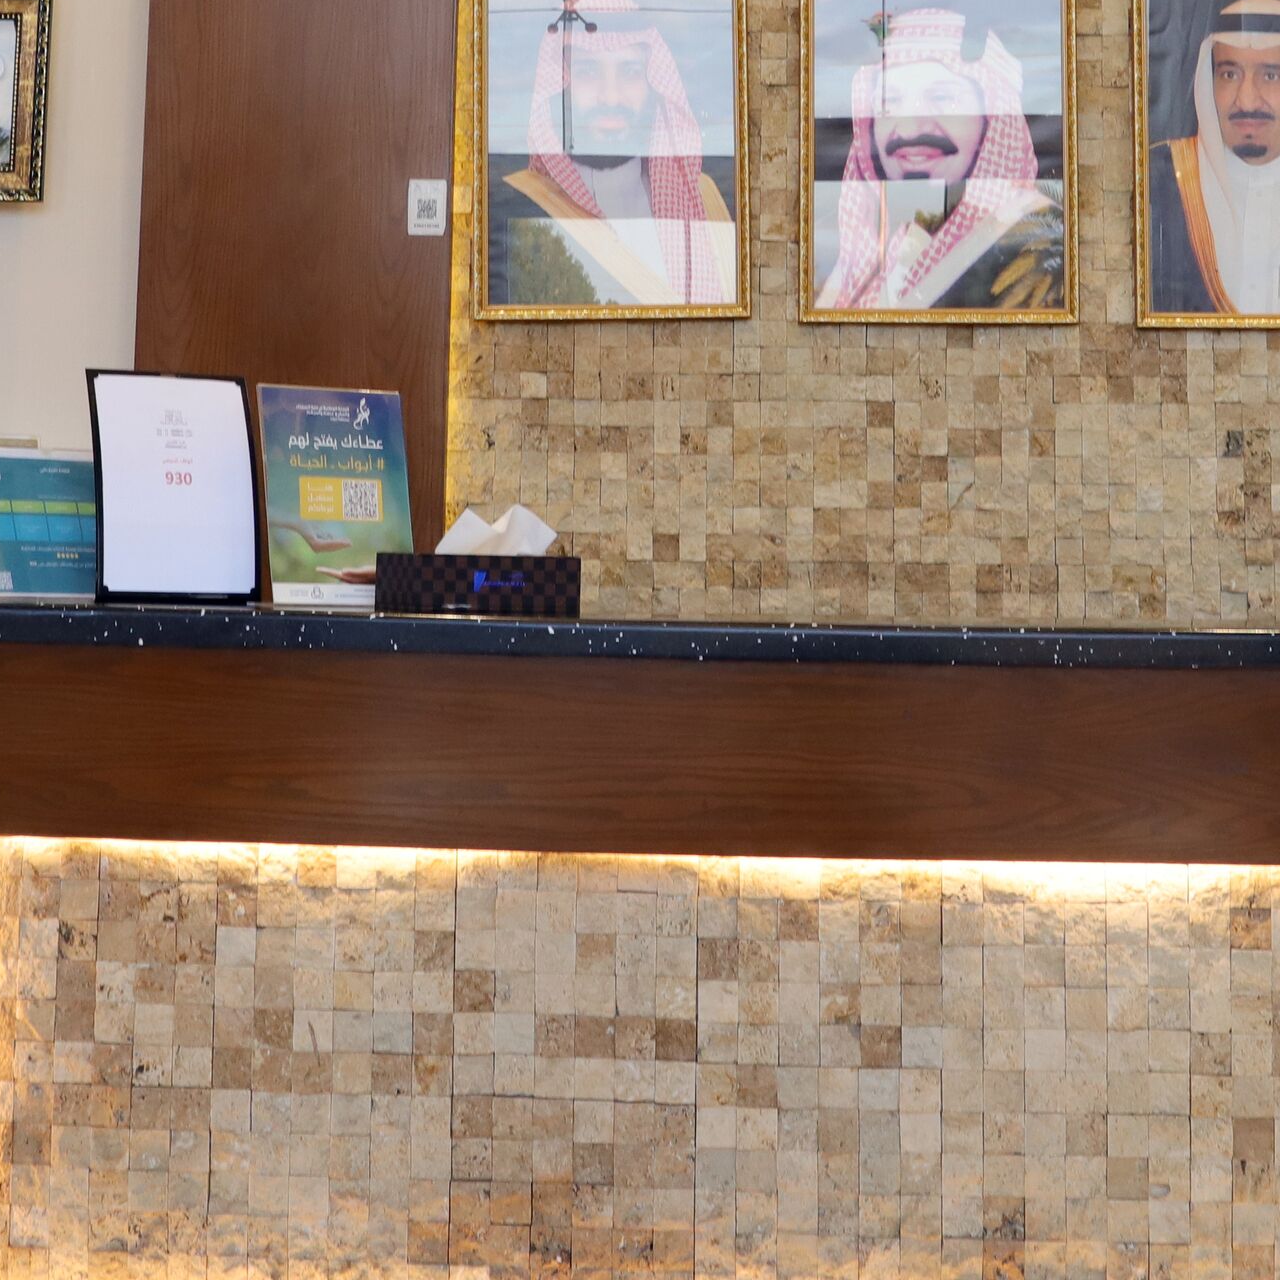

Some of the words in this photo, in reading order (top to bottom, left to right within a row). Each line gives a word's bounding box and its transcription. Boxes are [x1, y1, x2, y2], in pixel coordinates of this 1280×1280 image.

[288, 432, 310, 449] لهم
[314, 434, 338, 451] يفتح
[341, 434, 384, 450] عطاءك
[165, 471, 193, 486] 930
